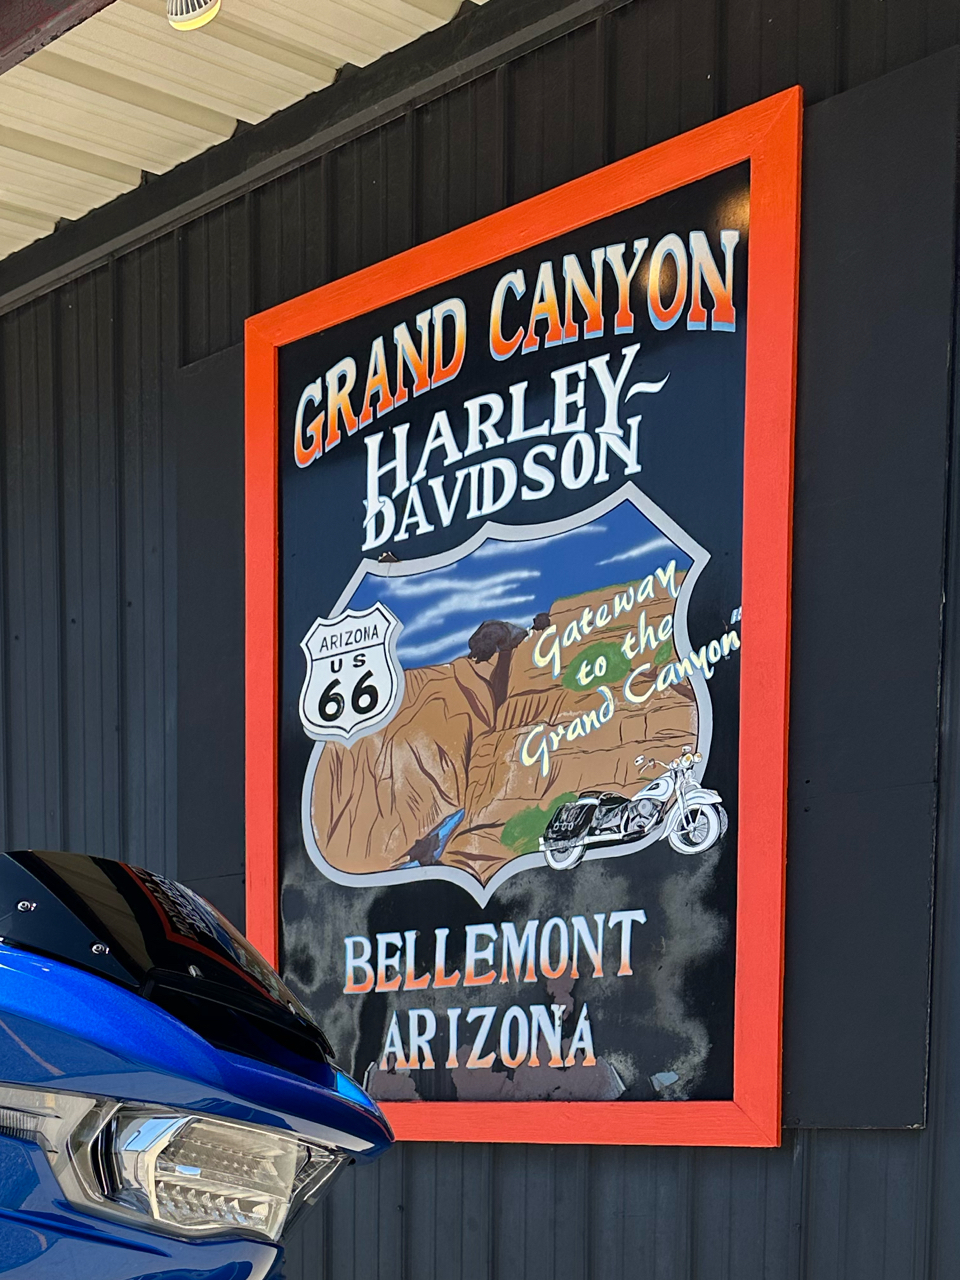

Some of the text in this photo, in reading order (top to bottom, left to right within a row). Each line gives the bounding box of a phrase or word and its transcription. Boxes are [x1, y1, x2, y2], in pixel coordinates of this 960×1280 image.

[293, 229, 740, 469] GRAND CANYON
[361, 415, 643, 552] DAVIDSON
[319, 624, 380, 653] ARIZONA
[576, 610, 674, 687] to the
[318, 670, 379, 722] 66
[520, 685, 616, 778] Grand
[343, 909, 648, 995] BELLEMONT
[379, 1002, 597, 1071] ARIZONA
